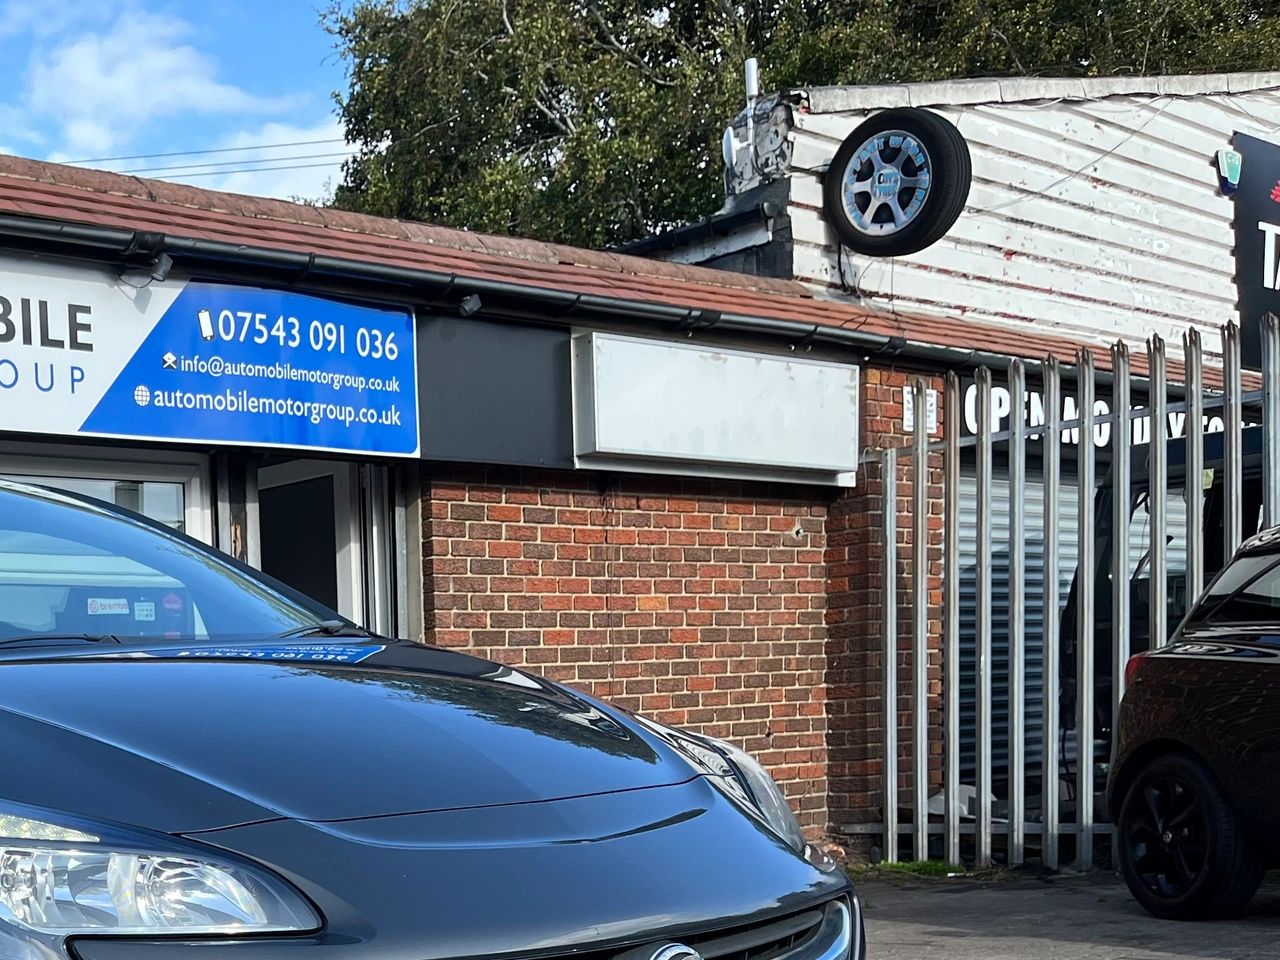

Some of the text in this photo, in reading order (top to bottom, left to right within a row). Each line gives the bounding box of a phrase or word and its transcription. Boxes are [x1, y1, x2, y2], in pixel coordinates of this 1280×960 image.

[1258, 221, 1280, 291] T
[218, 310, 398, 361] 07543 091 036
[180, 354, 400, 393] info@automobilemotorgroup.co.uk
[153, 388, 401, 427] automobilemotorgroup.co.uk
